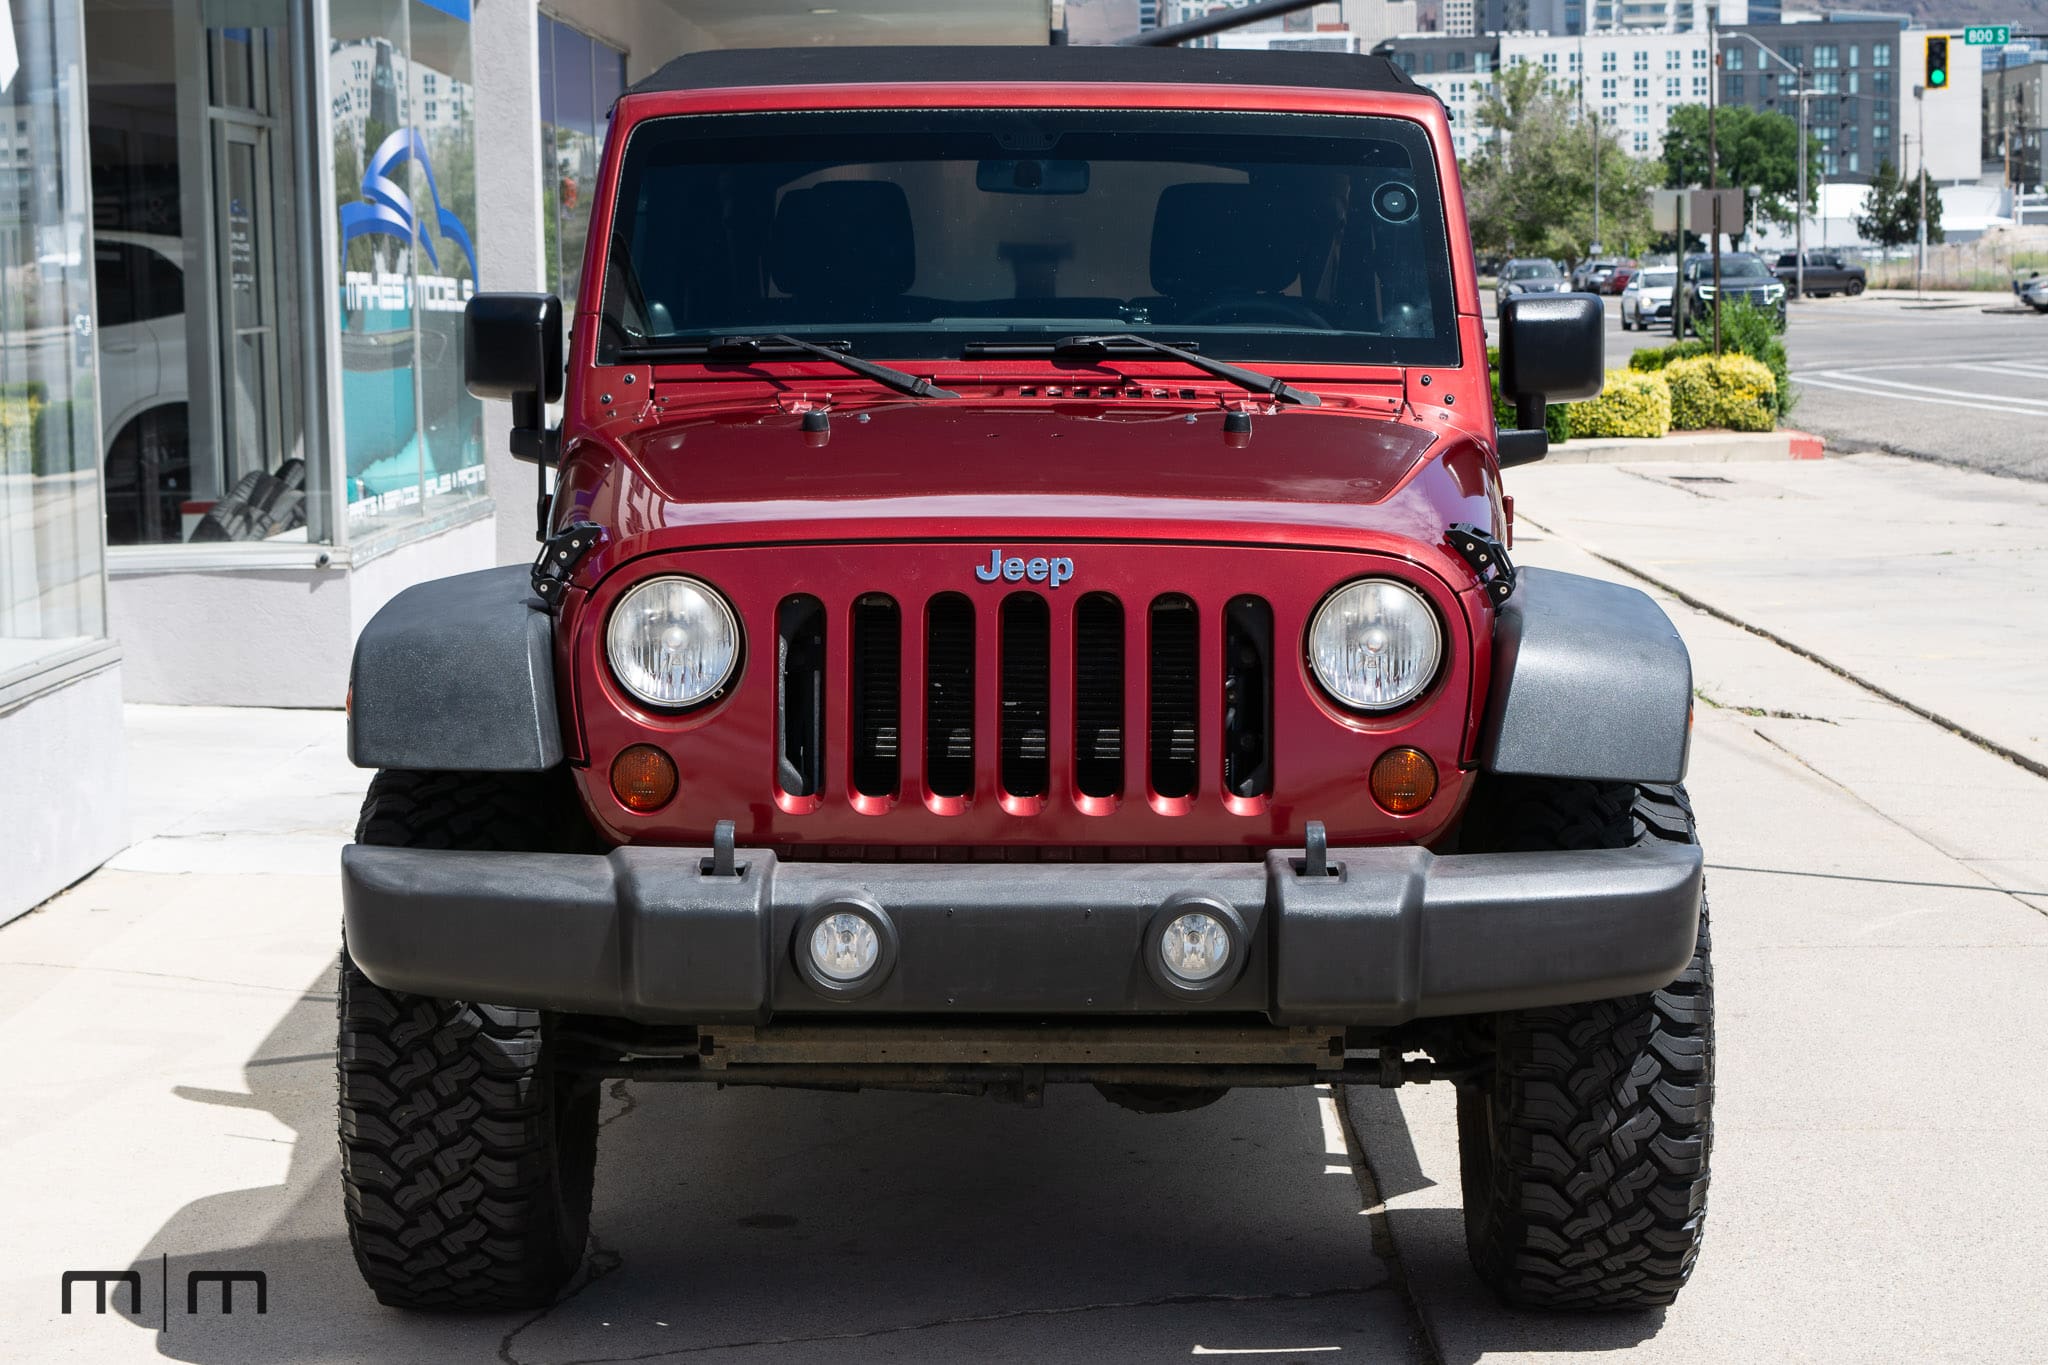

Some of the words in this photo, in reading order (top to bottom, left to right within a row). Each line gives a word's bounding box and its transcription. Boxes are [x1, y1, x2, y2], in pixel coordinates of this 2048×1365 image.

[1968, 29, 1993, 43] 800
[1997, 29, 2006, 42] S
[976, 549, 1074, 587] Jeep
